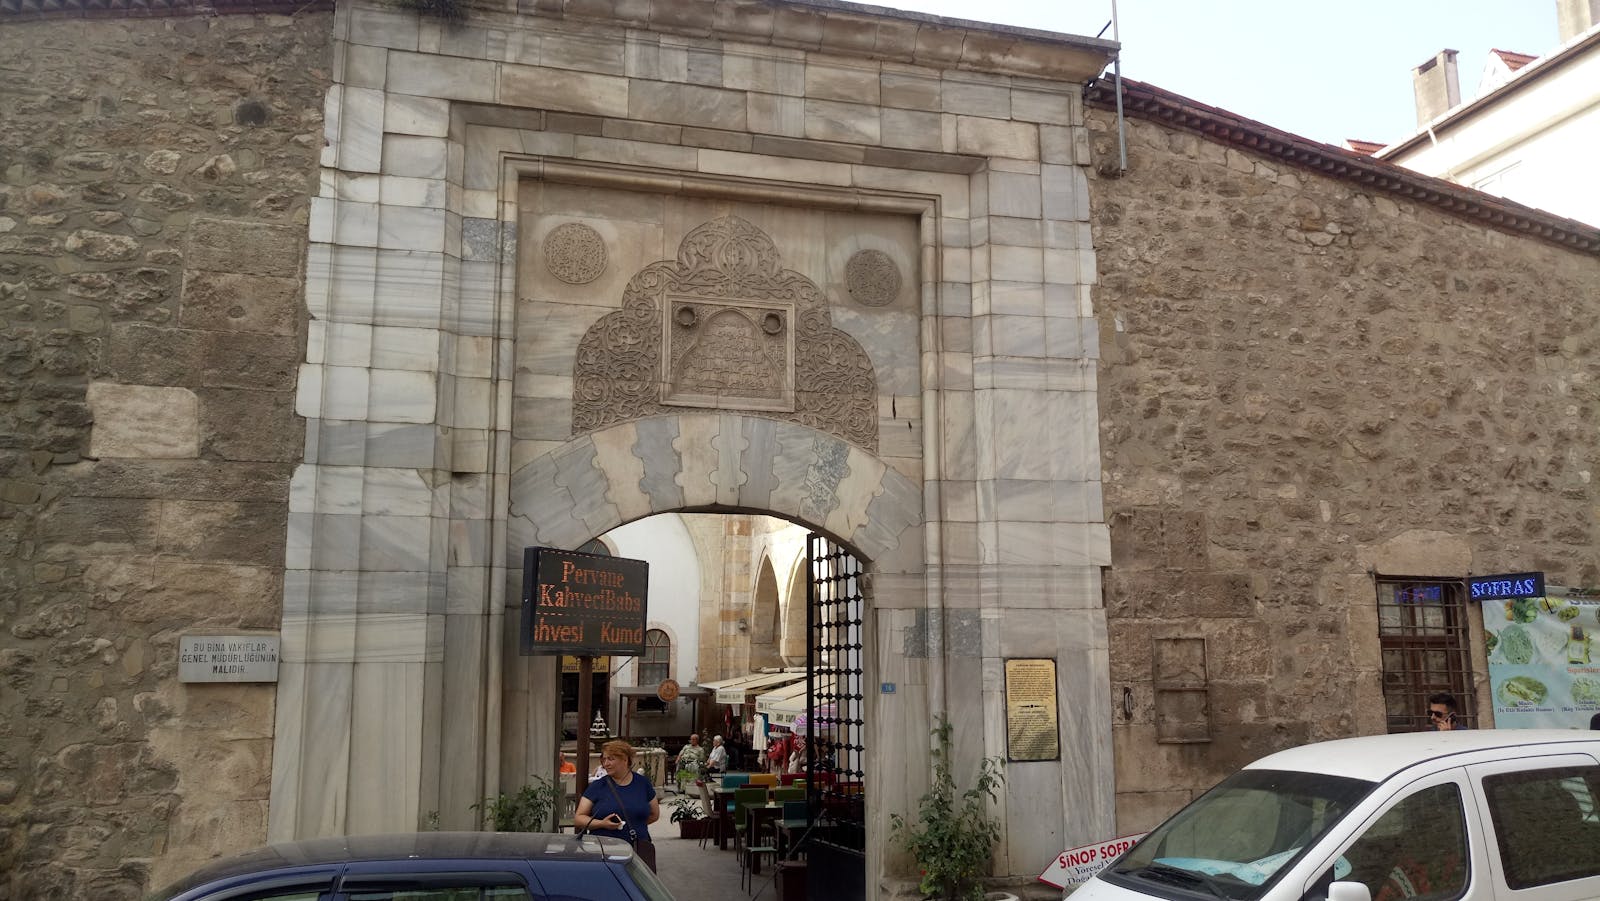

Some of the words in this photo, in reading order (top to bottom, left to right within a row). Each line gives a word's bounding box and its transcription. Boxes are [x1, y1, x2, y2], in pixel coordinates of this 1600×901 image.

[561, 561, 624, 587] Pervane
[193, 643, 205, 652] BU
[182, 654, 208, 663] GENEL
